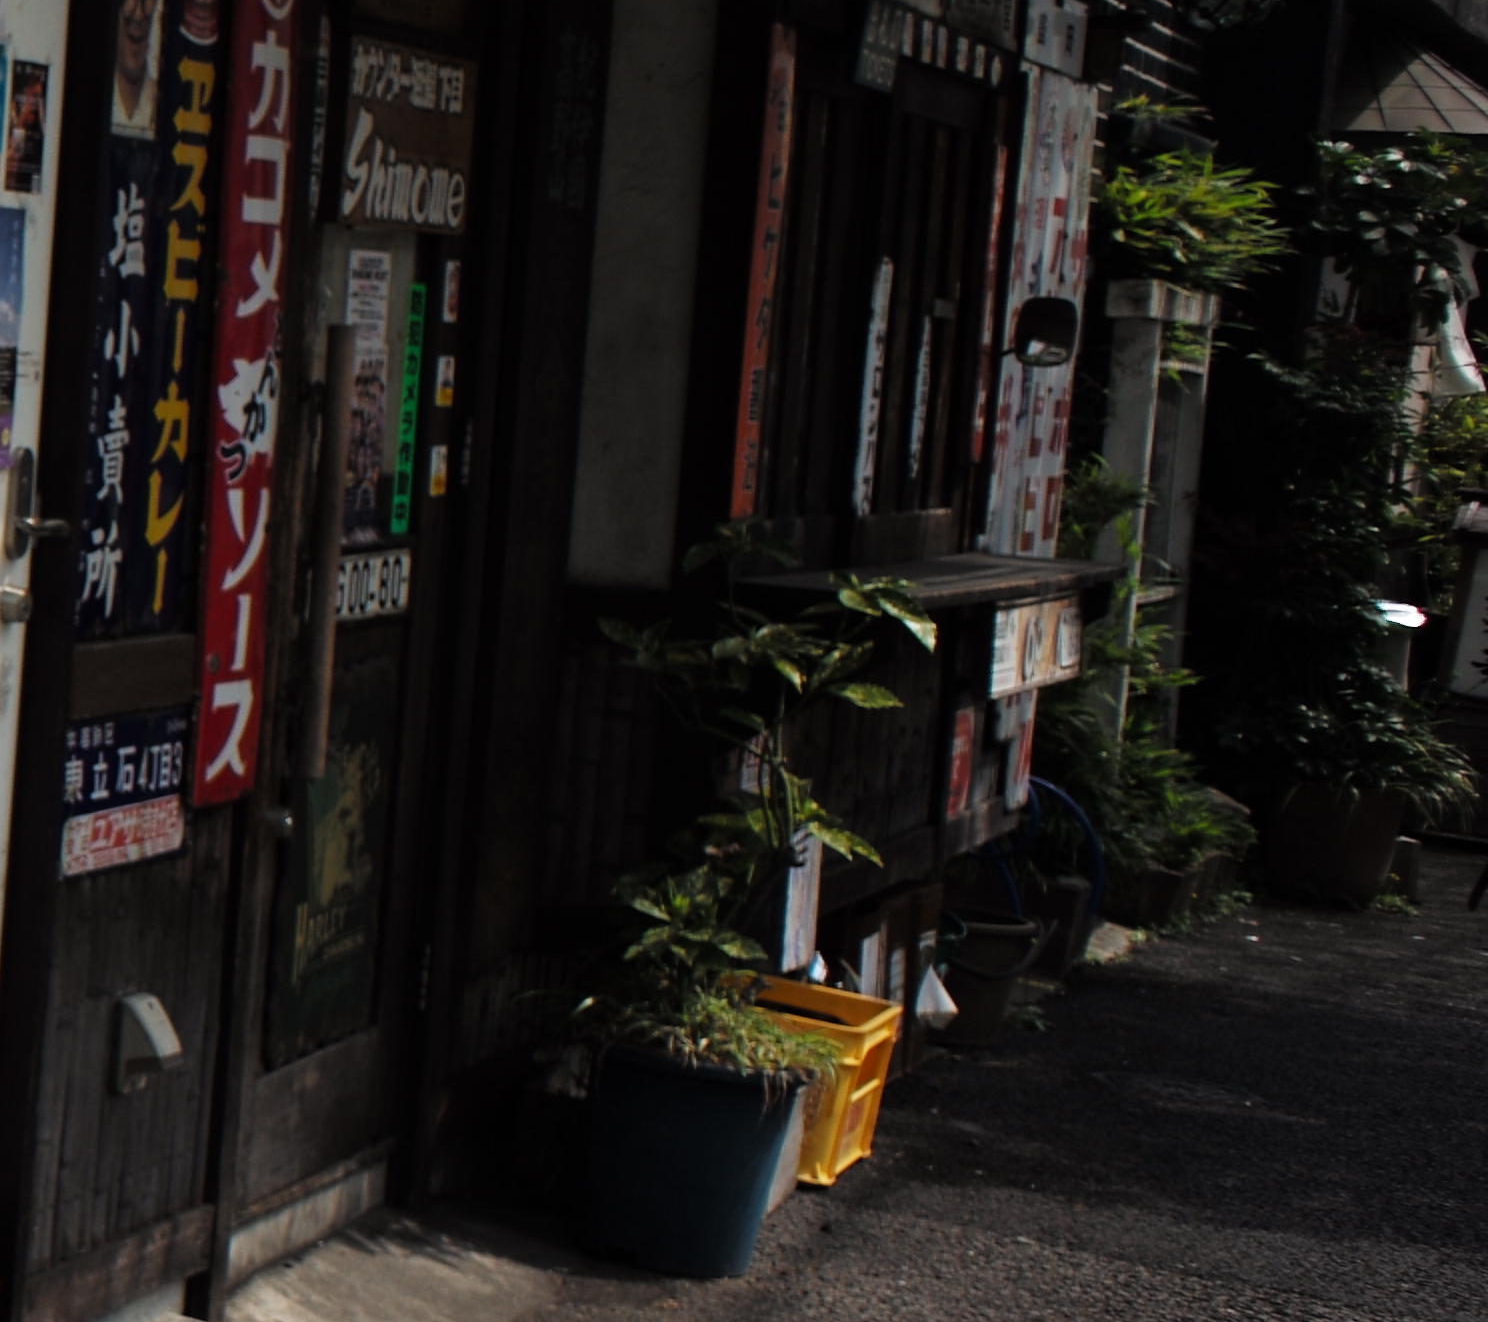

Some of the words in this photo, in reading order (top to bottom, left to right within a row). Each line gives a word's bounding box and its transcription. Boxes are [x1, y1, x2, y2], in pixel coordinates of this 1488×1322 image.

[341, 105, 466, 230] Shimome
[204, 486, 272, 785] ソース
